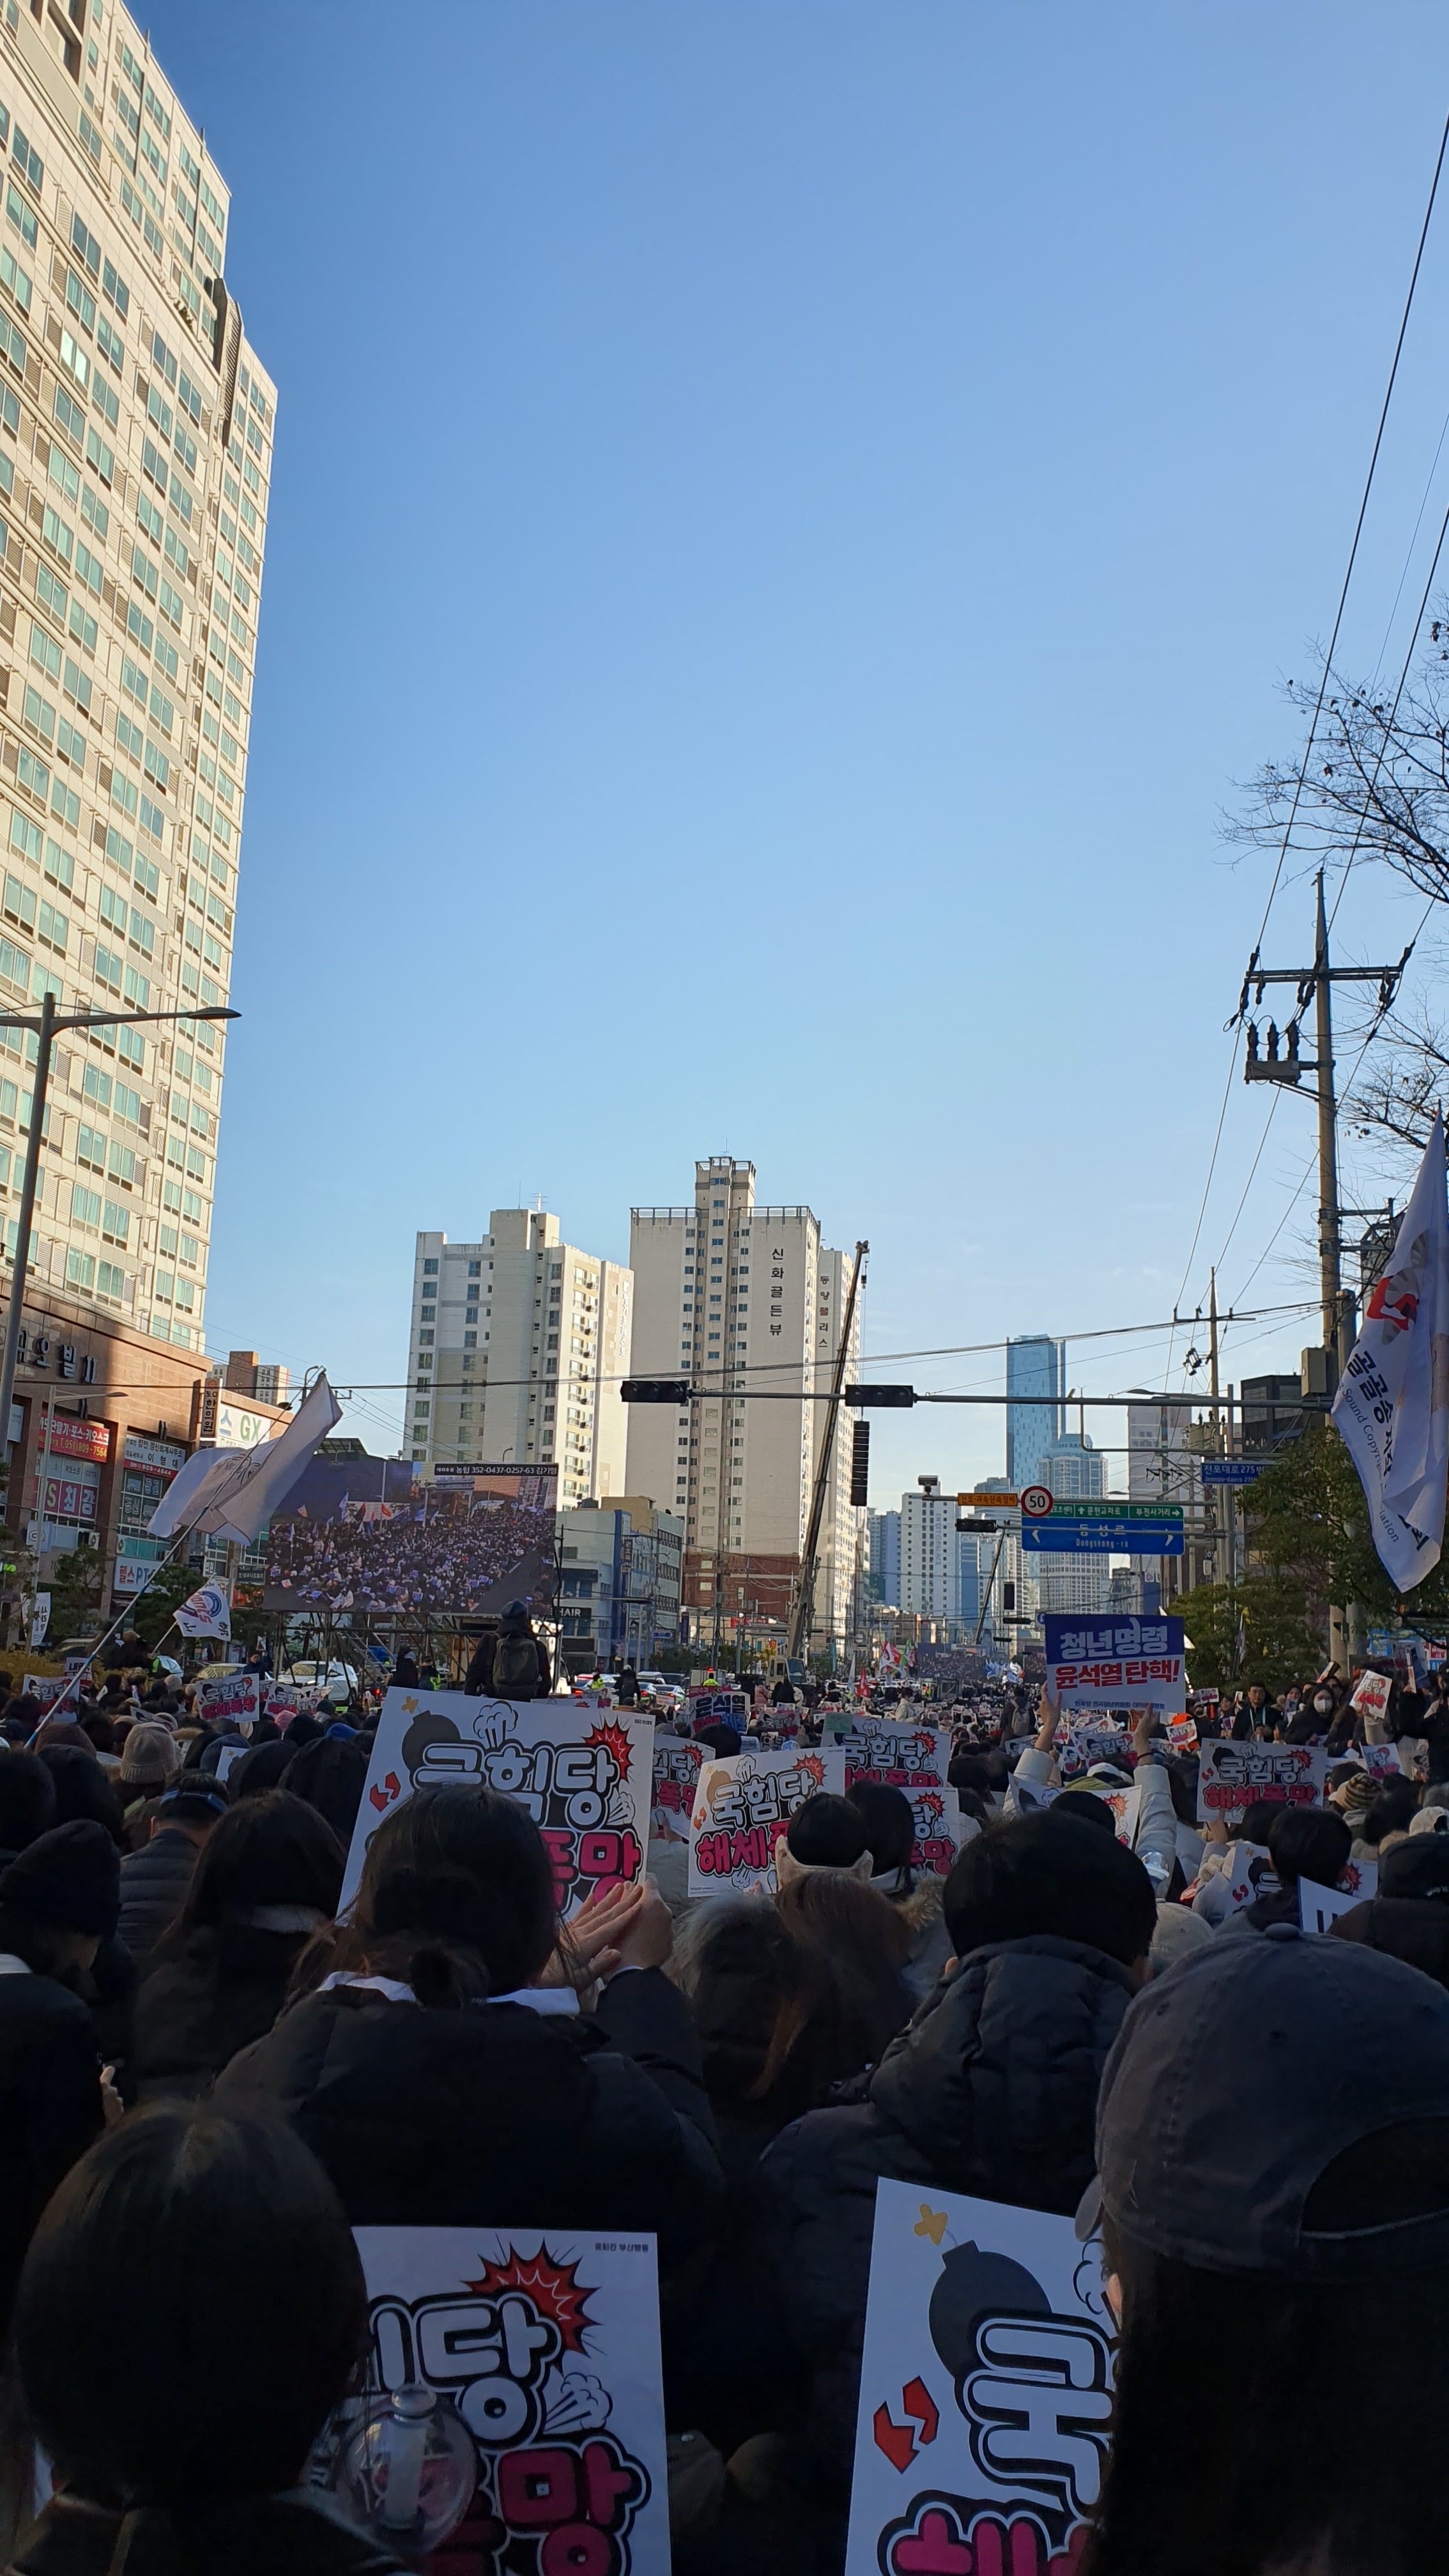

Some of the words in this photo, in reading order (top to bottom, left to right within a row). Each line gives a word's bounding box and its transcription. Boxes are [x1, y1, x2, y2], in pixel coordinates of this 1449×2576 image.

[769, 1248, 785, 1336] 신화골든뷰
[818, 1276, 830, 1348] 동양팰리스
[1342, 1387, 1368, 1423] Sound
[240, 1414, 262, 1442] GX
[63, 1485, 96, 1515] 최강
[1029, 1495, 1045, 1508] 50
[1050, 1505, 1073, 1514] 포츠센터
[1087, 1506, 1121, 1516] 문현교차로
[1135, 1508, 1170, 1517] 부전사거리
[1055, 1662, 1123, 1690] 윤석열
[1125, 1659, 1181, 1685] 탄핵!
[206, 1681, 249, 1703] 국힘당
[695, 1694, 746, 1719] 윤석열
[841, 1731, 930, 1772] 국힘당
[1090, 1736, 1131, 1758] 국힘당
[1216, 1753, 1307, 1785] 국힘당
[711, 1768, 818, 1827] 국힘당
